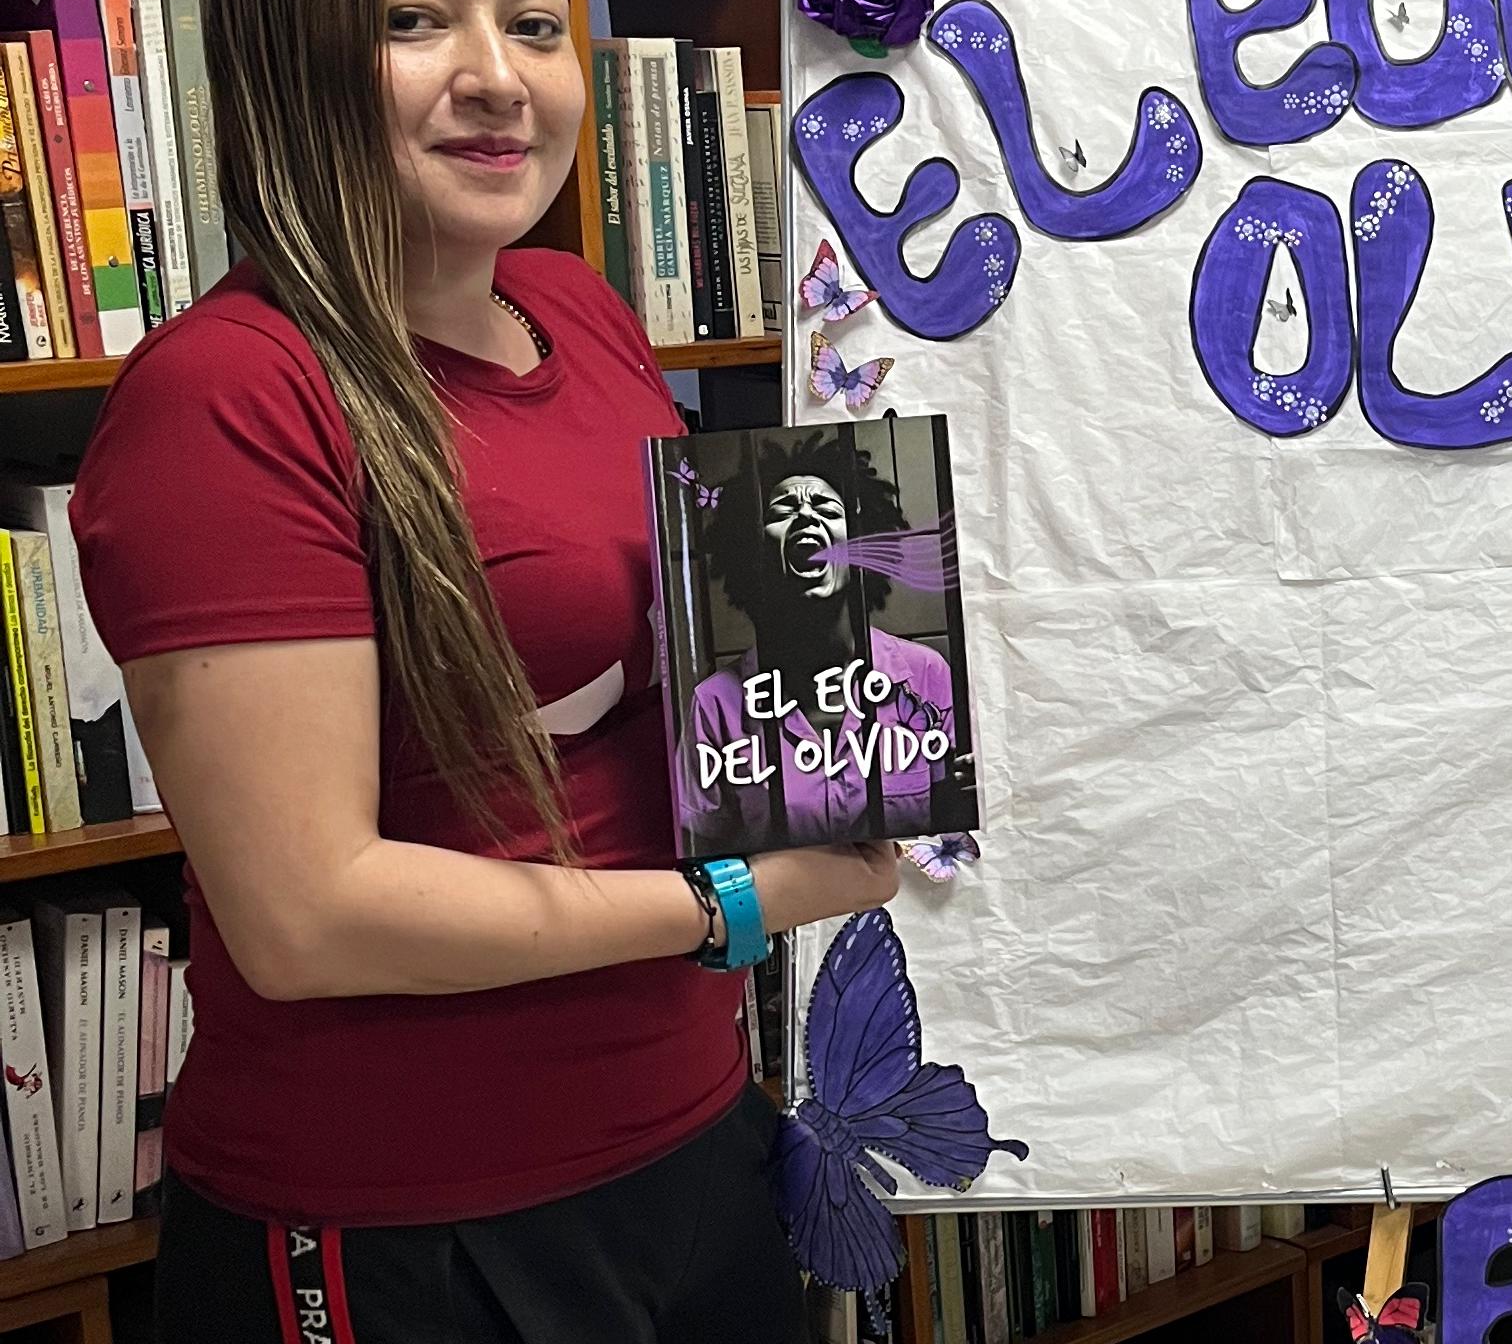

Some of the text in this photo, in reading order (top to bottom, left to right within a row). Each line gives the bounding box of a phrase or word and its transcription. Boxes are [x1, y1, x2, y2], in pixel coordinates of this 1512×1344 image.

[647, 60, 664, 157] Notas de prensa
[685, 117, 693, 144] JAVIER
[186, 87, 211, 224] CRIMINOLOGÍA
[604, 170, 617, 185] del
[59, 193, 79, 271] DE LA GERENCIA
[71, 218, 86, 260] ASUNTOS
[137, 212, 154, 254] JURÍDICA
[608, 212, 620, 224] El
[659, 165, 675, 275] GARCÍA MÁRQUEZ
[78, 262, 89, 280] LOS
[654, 225, 667, 276] GABRIEL
[81, 281, 91, 295] DE
[32, 565, 47, 634] URBANIDAD
[743, 658, 892, 720] EL ECO
[696, 722, 950, 791] DEL OLVIDO
[12, 955, 27, 1015] MANFREDI
[79, 934, 88, 1005] DANIEL MASON
[117, 928, 127, 999] DANIEL MASON
[6, 992, 18, 1040] VALERIO
[77, 1083, 86, 1093] DE
